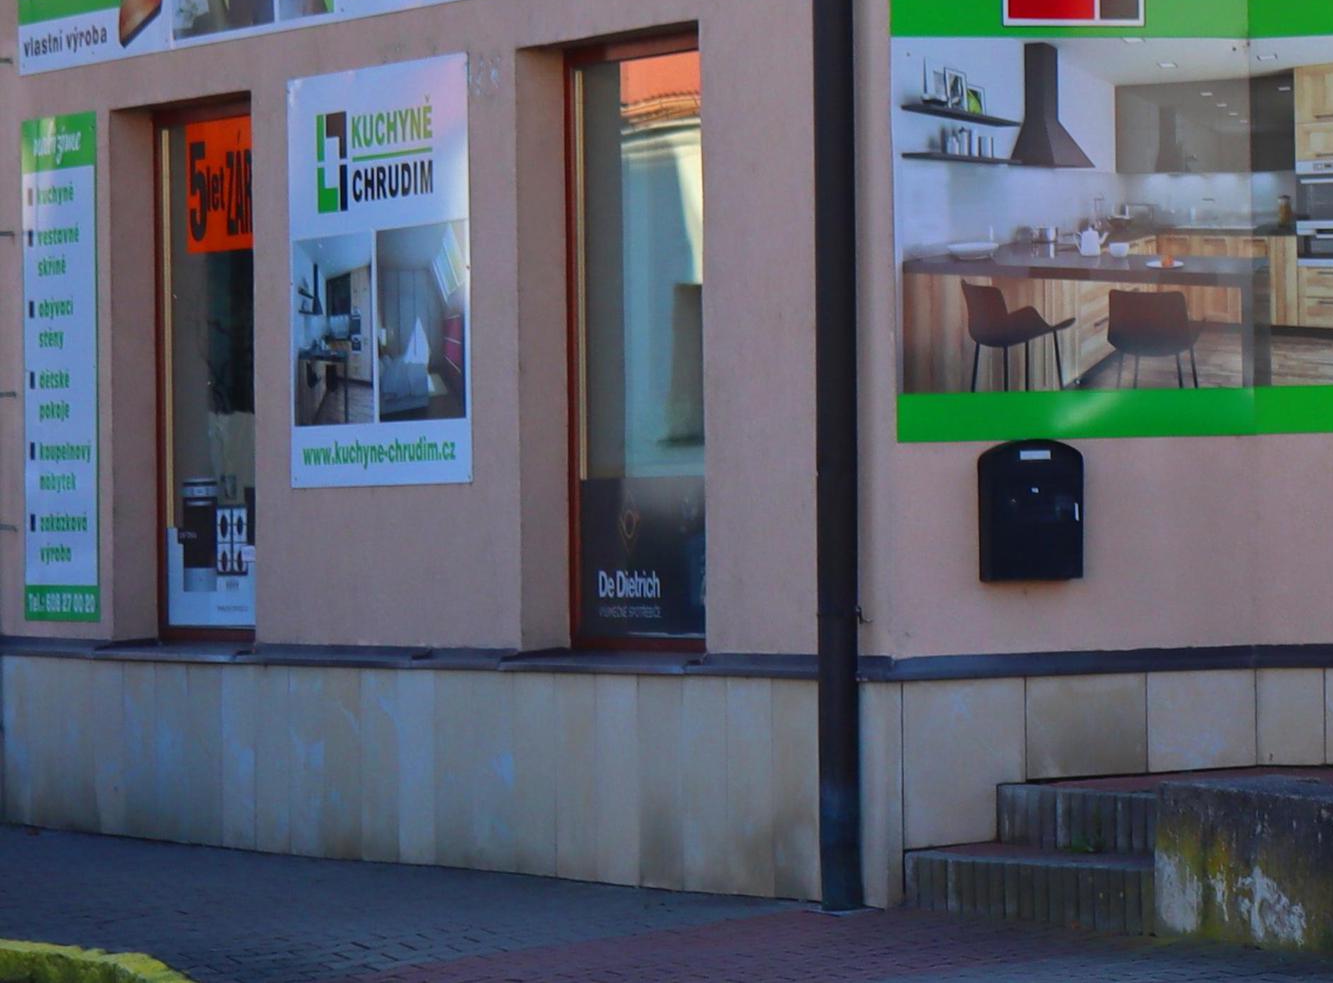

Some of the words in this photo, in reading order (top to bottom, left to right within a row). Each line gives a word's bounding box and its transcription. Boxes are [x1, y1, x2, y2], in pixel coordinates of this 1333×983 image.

[24, 32, 63, 58] vlastní
[65, 25, 108, 53] výroba
[351, 94, 433, 149] KUCHYNĚ
[352, 160, 433, 203] CHRUDIM
[303, 436, 456, 470] www.kuchyne-chrudim.cz
[598, 569, 615, 598] De
[616, 569, 661, 598] Dietrich
